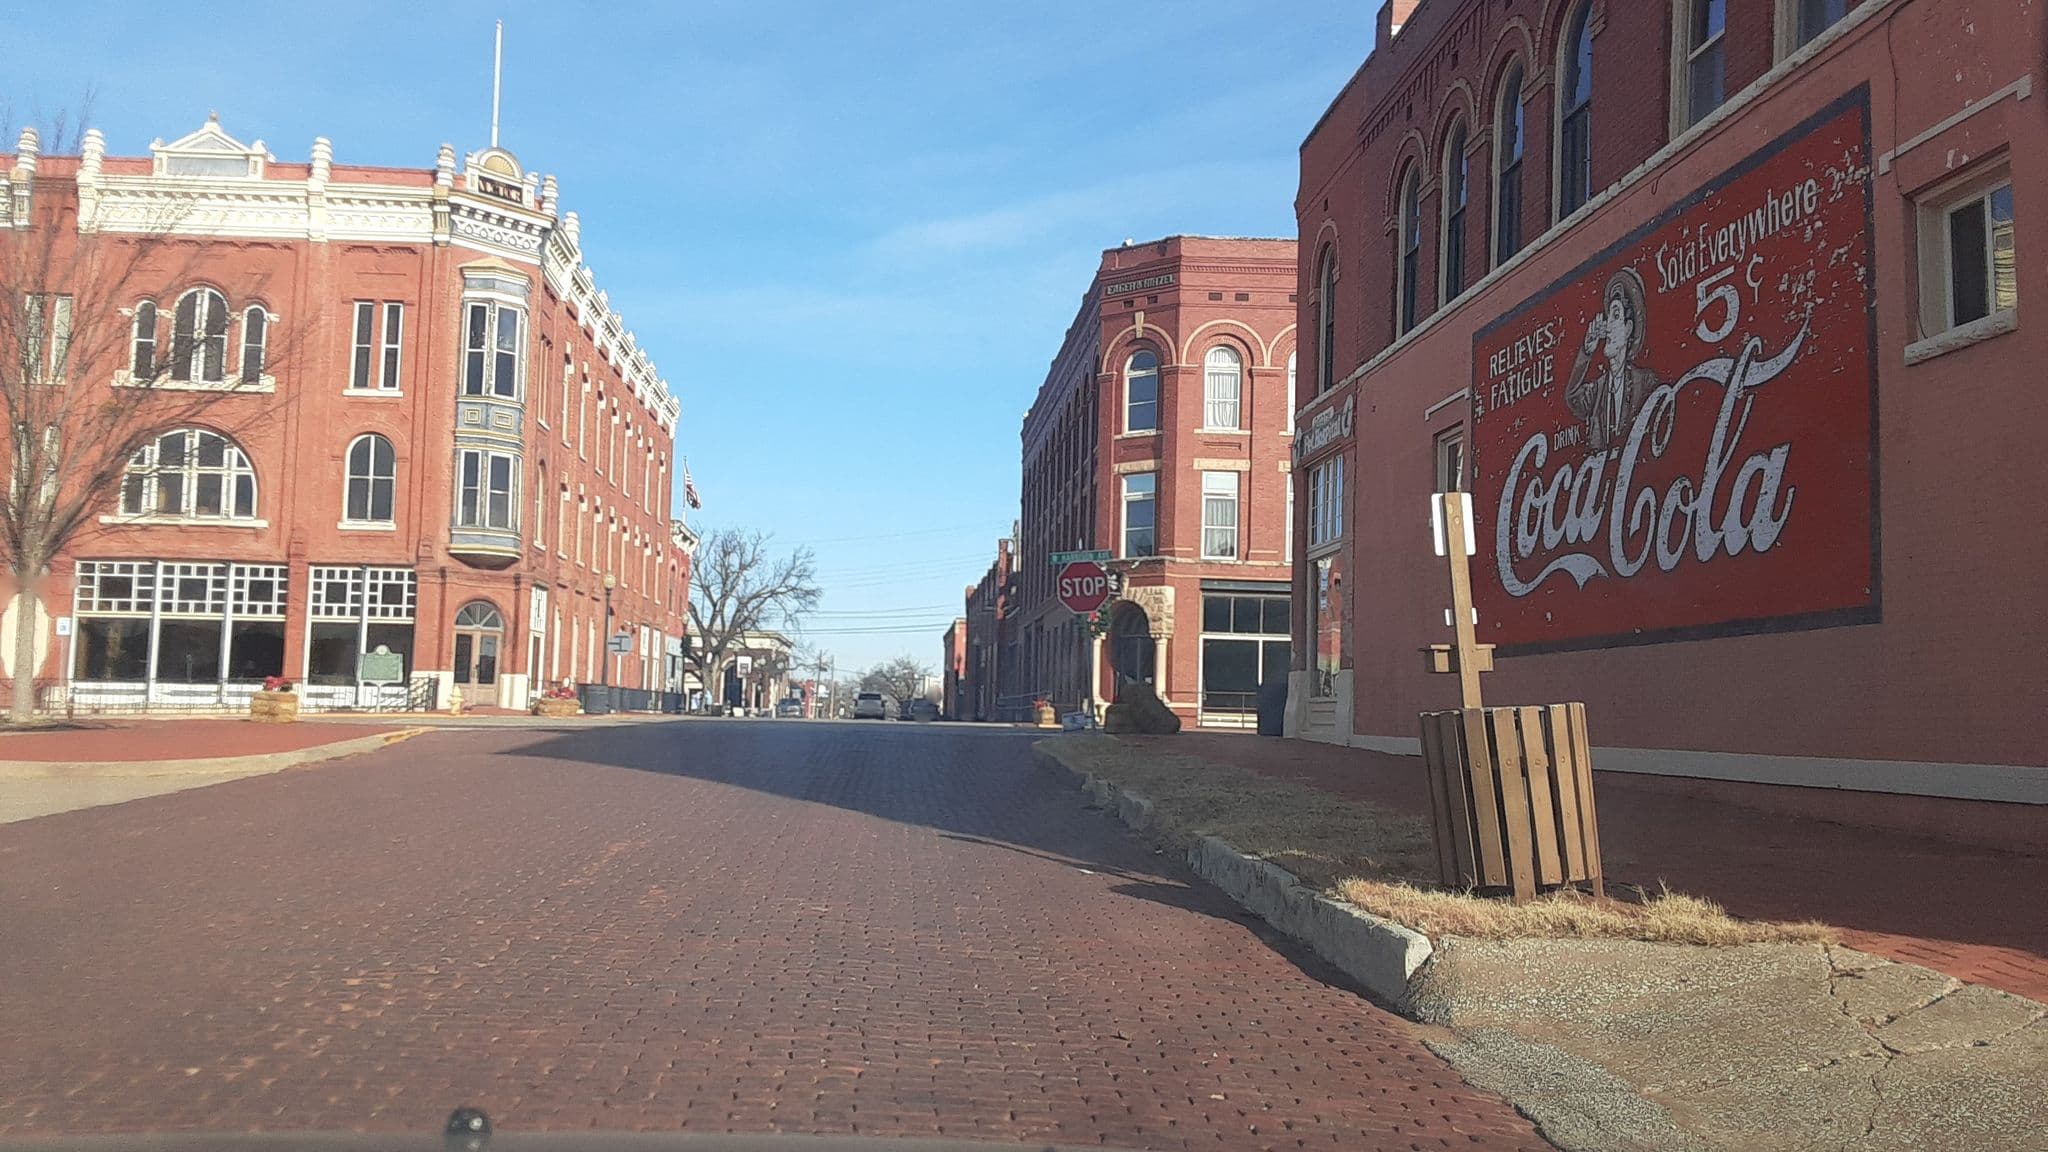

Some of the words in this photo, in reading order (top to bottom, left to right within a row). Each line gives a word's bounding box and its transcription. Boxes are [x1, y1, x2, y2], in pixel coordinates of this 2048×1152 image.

[1698, 177, 1819, 273] Everywhere
[1489, 322, 1555, 379] RELIEVES
[1490, 354, 1555, 411] FATIGUE
[1553, 425, 1581, 451] DRINK
[1061, 577, 1105, 597] STOP
